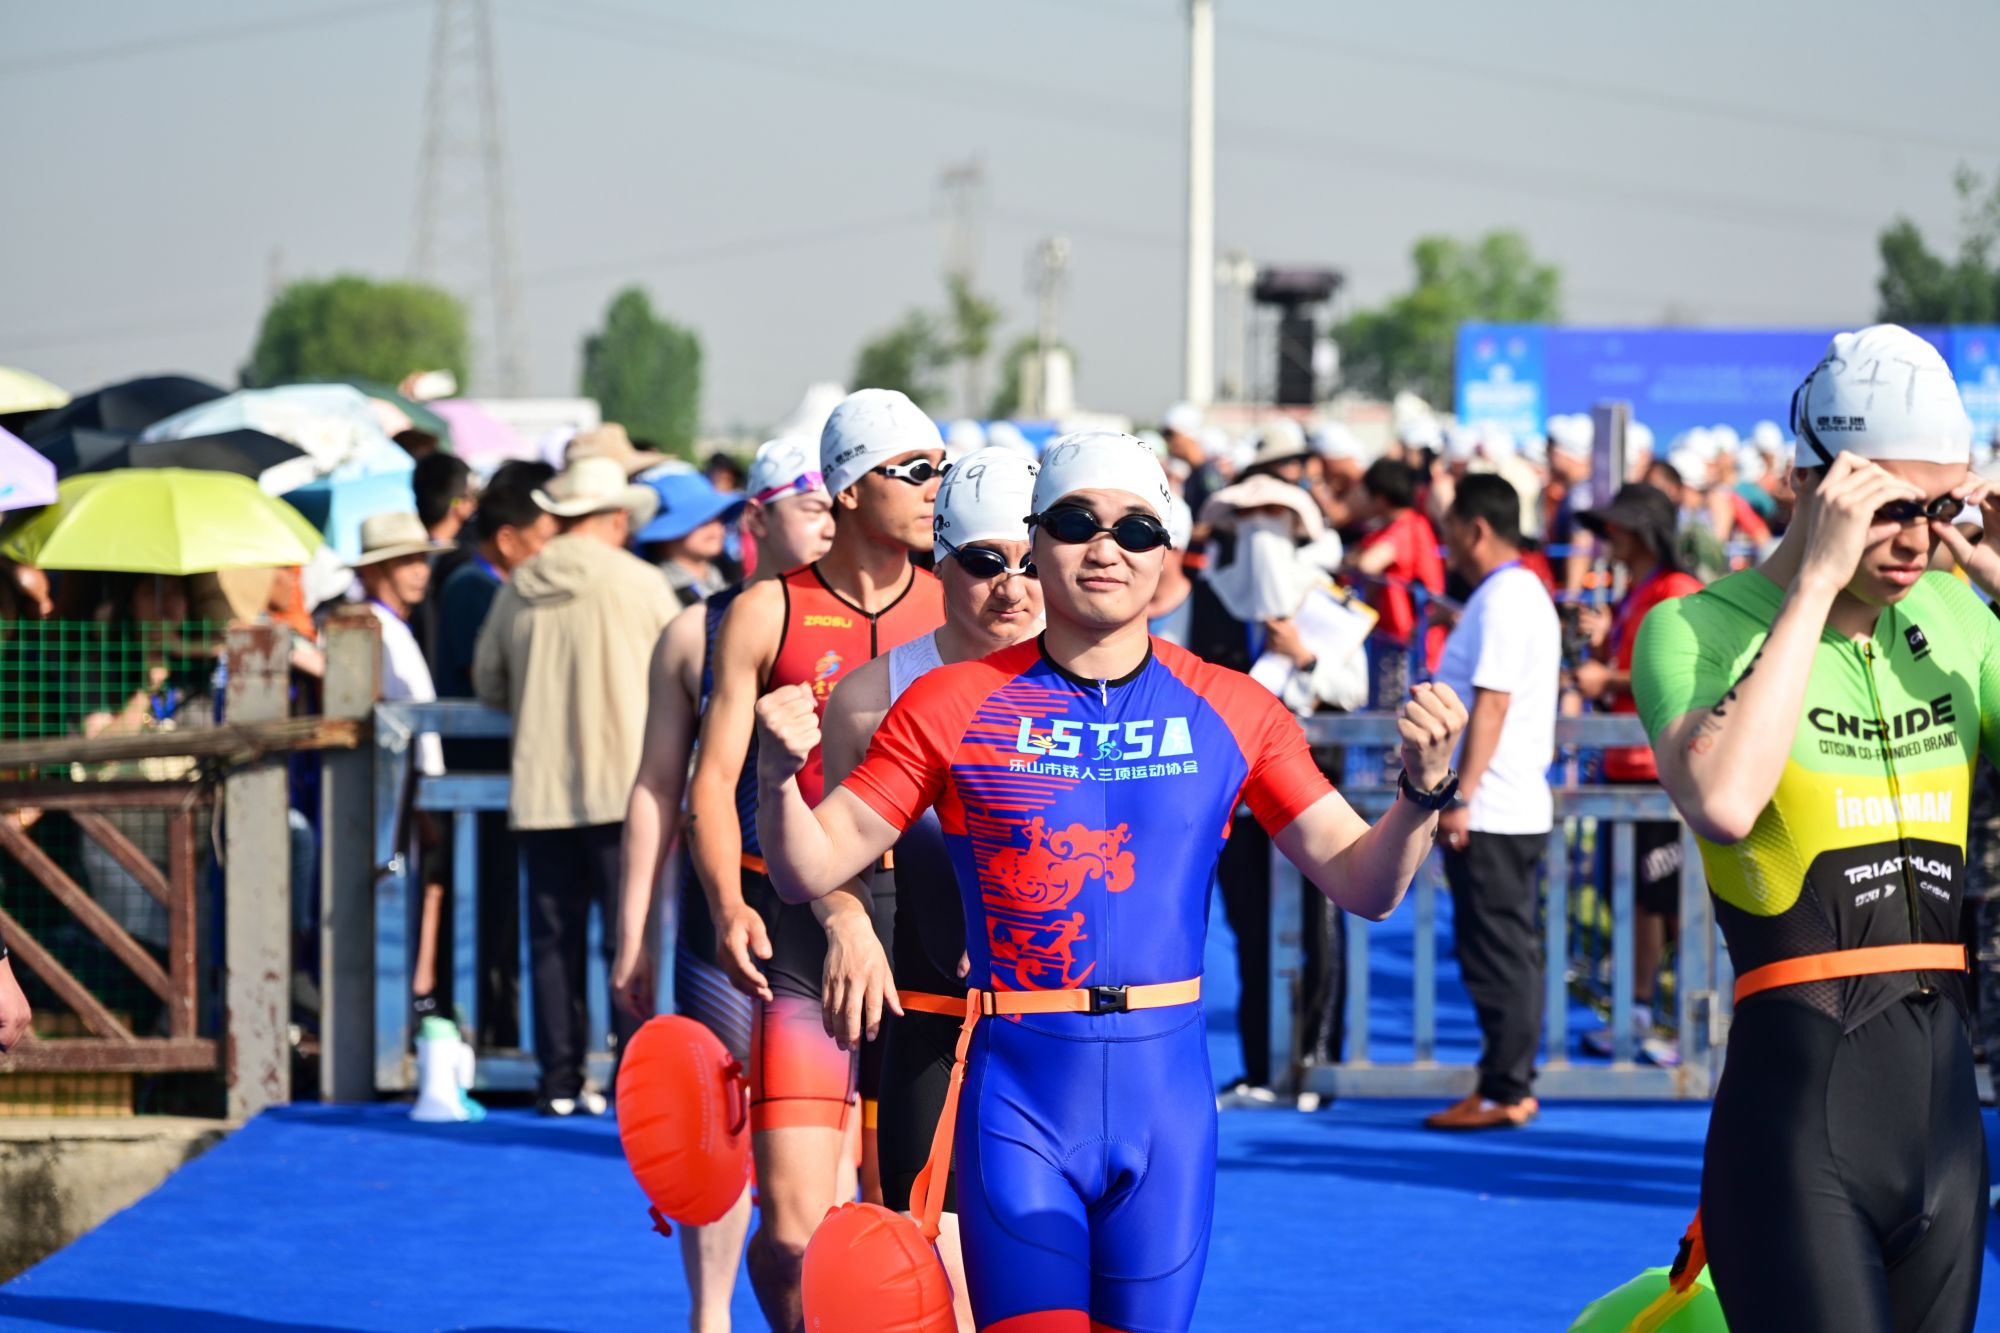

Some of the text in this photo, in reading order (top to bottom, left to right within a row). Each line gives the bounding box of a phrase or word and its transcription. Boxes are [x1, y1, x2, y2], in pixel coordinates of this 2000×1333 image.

[803, 615, 853, 629] ZAOSU
[1808, 692, 1956, 741] CNRIDE
[1016, 716, 1194, 761] LSTSA
[1923, 730, 1958, 752] BRAND
[1009, 758, 1199, 782] 乐山市铁人三项运动协会
[1844, 855, 1952, 882] TRIATHLON
